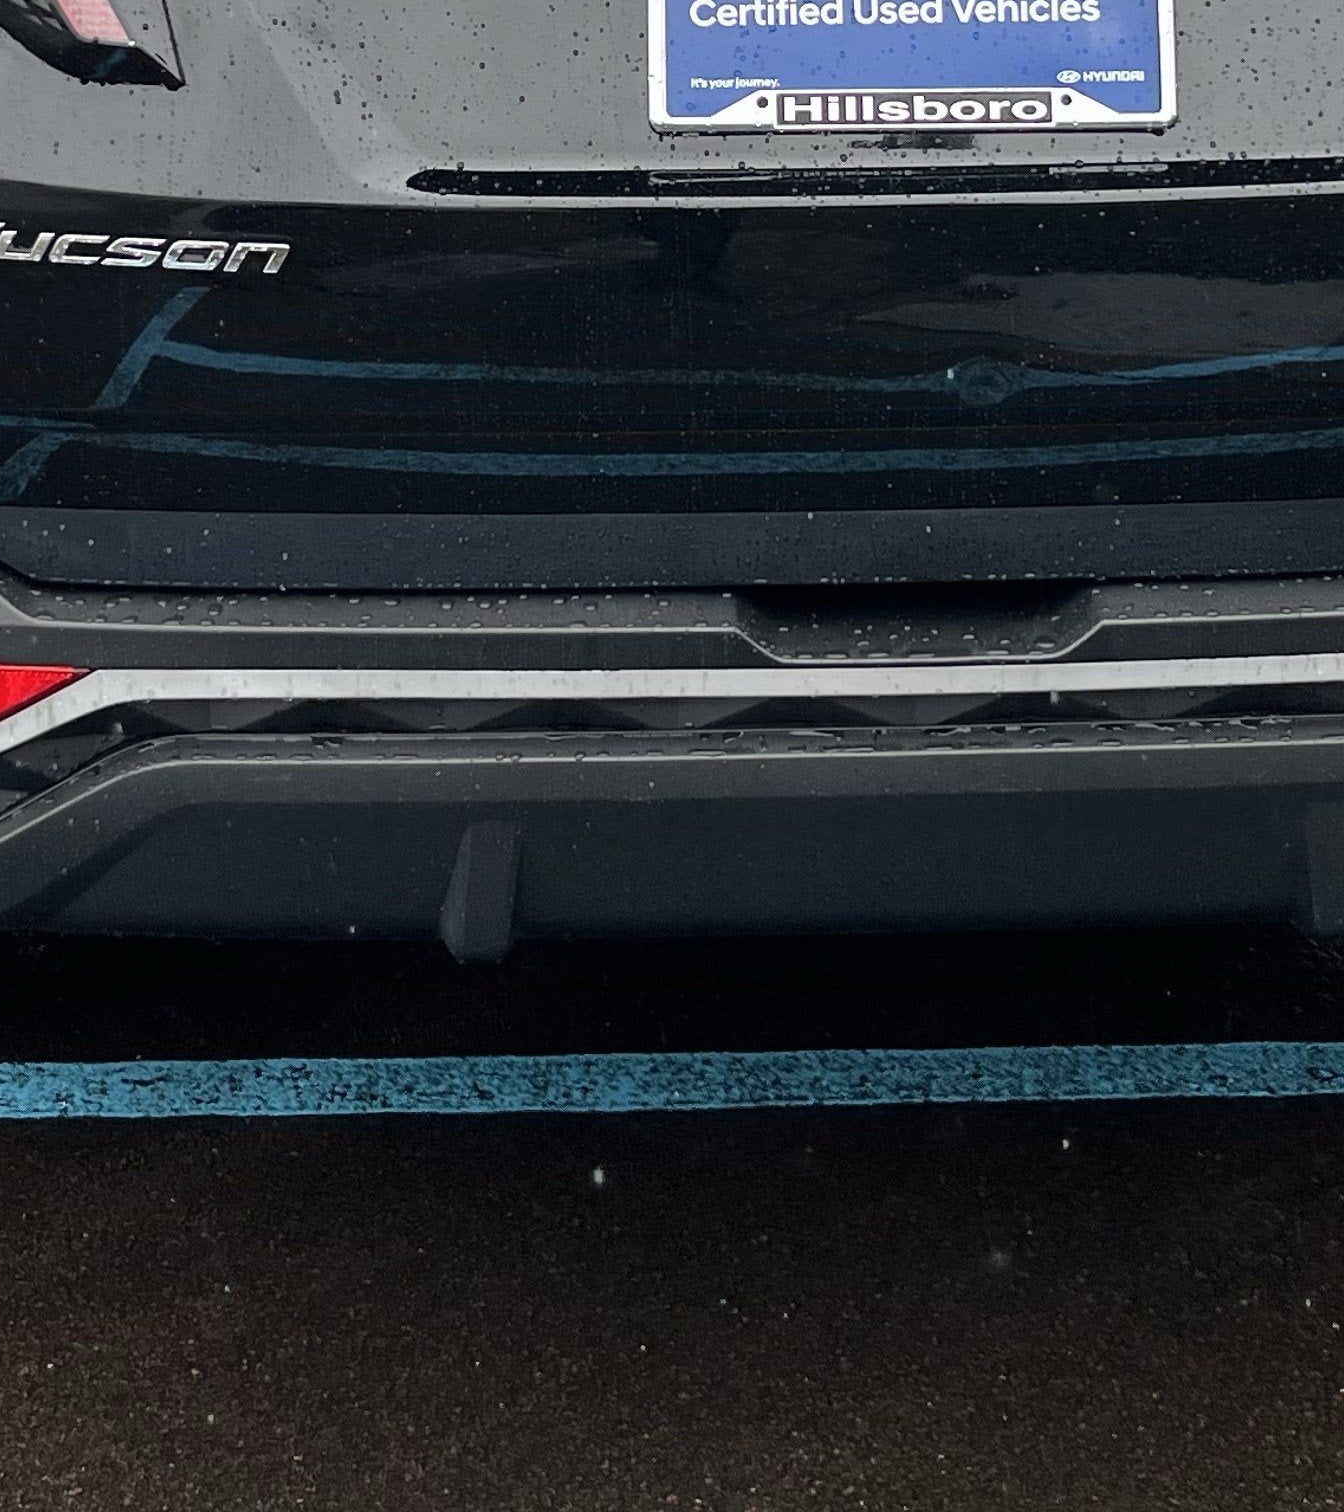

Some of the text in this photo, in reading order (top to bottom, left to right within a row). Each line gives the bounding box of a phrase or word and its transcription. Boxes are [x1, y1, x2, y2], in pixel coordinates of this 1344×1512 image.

[1082, 70, 1145, 83] HYUNDAI
[709, 78, 734, 90] your
[783, 95, 1049, 122] Hillsboro
